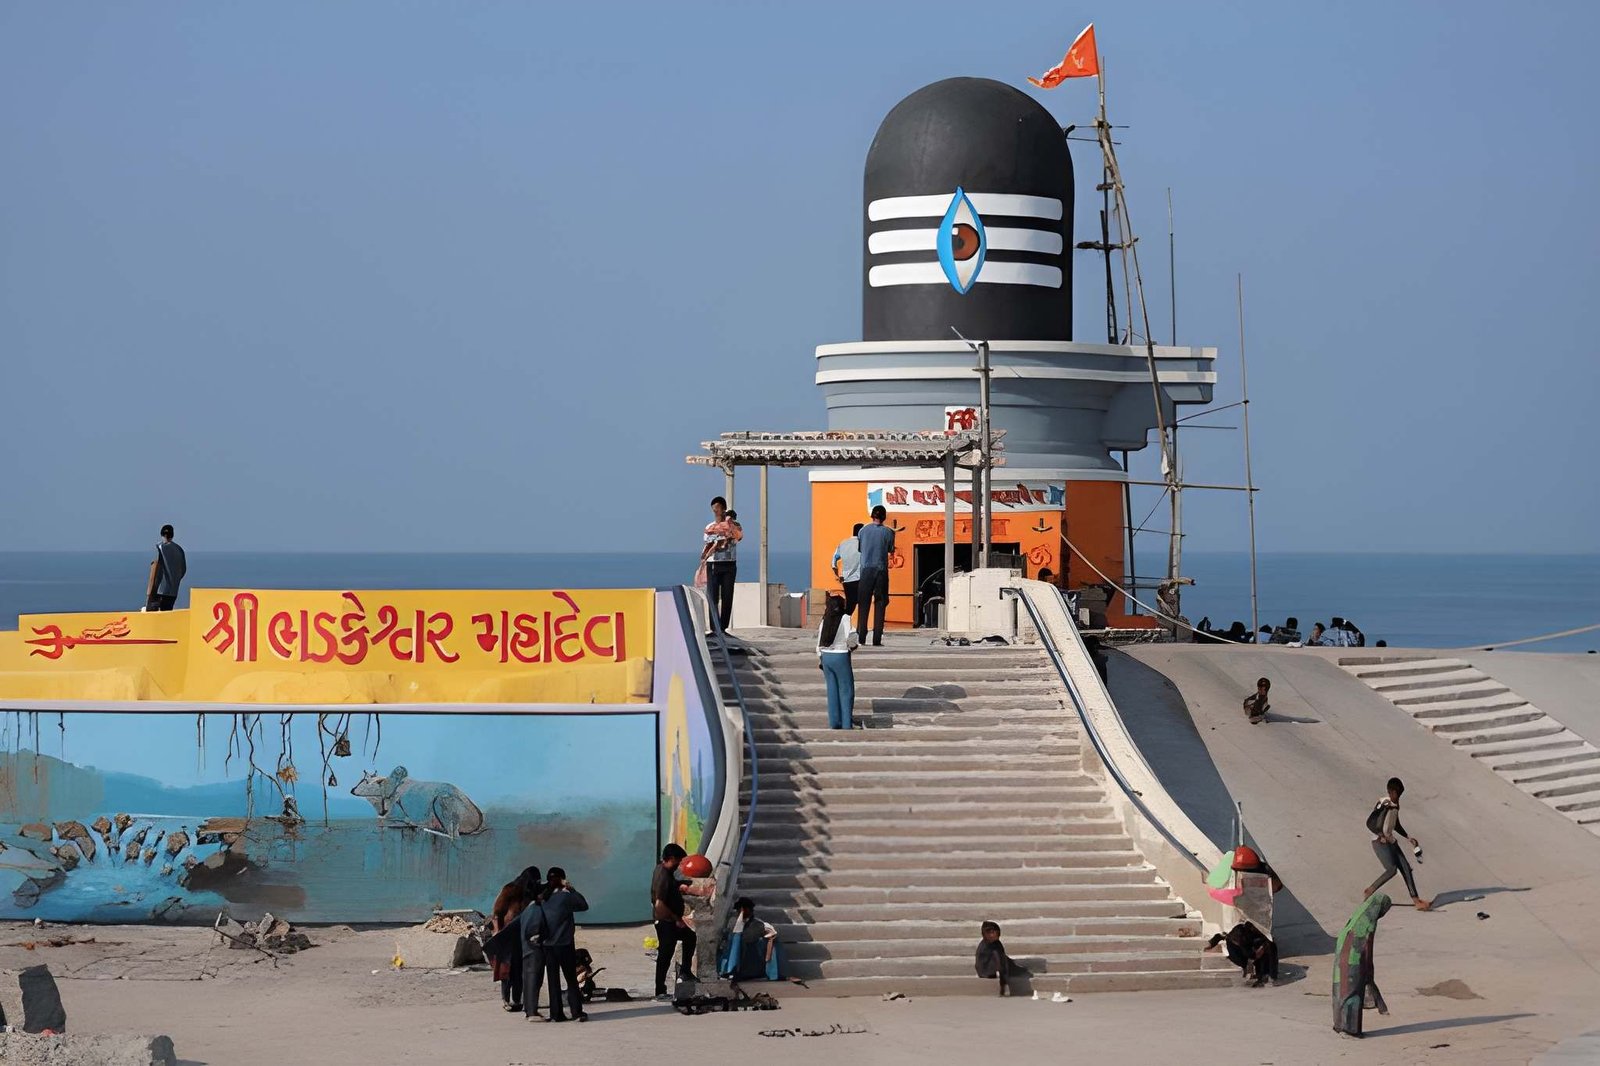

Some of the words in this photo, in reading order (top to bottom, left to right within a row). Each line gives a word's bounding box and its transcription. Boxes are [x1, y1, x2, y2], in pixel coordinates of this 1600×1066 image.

[202, 592, 259, 662] શ્રી
[268, 591, 460, 665] ભડકેશ્વર
[471, 591, 626, 663] મહાદેવ
